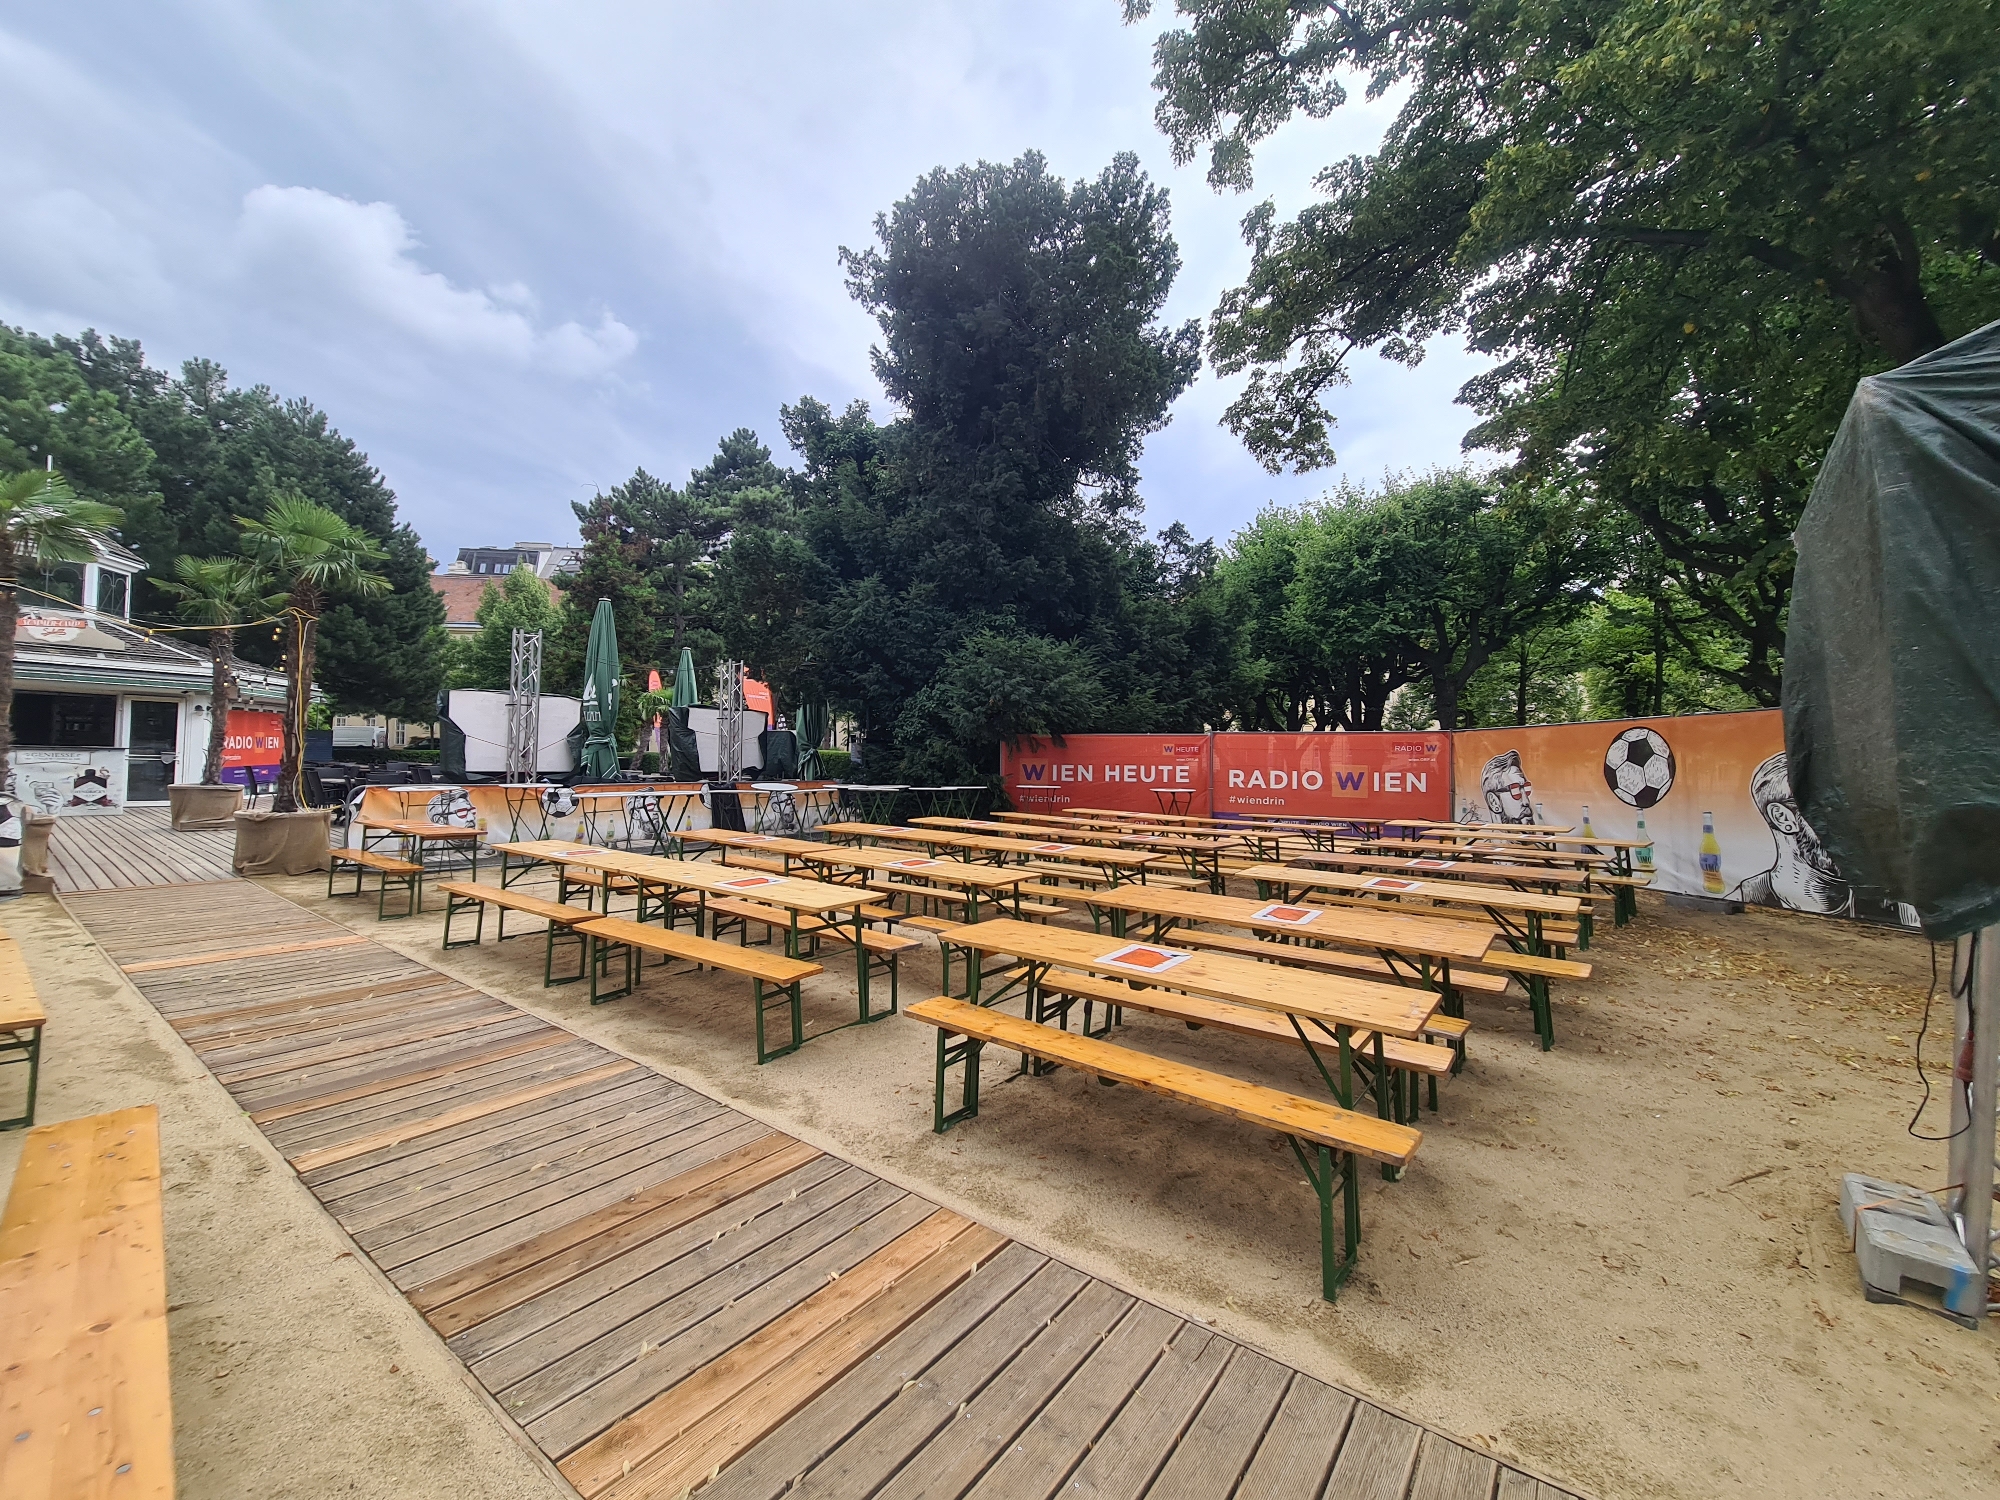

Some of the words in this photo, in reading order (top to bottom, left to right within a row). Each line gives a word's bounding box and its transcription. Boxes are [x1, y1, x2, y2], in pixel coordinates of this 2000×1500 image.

[1021, 763, 1093, 782] WIEN
[1104, 764, 1190, 783] HEUTE
[1228, 769, 1324, 791] RADIO
[1334, 771, 1427, 793] WIEN
[1019, 794, 1070, 803] #wiendrin
[1228, 795, 1285, 806] #wiendrin
